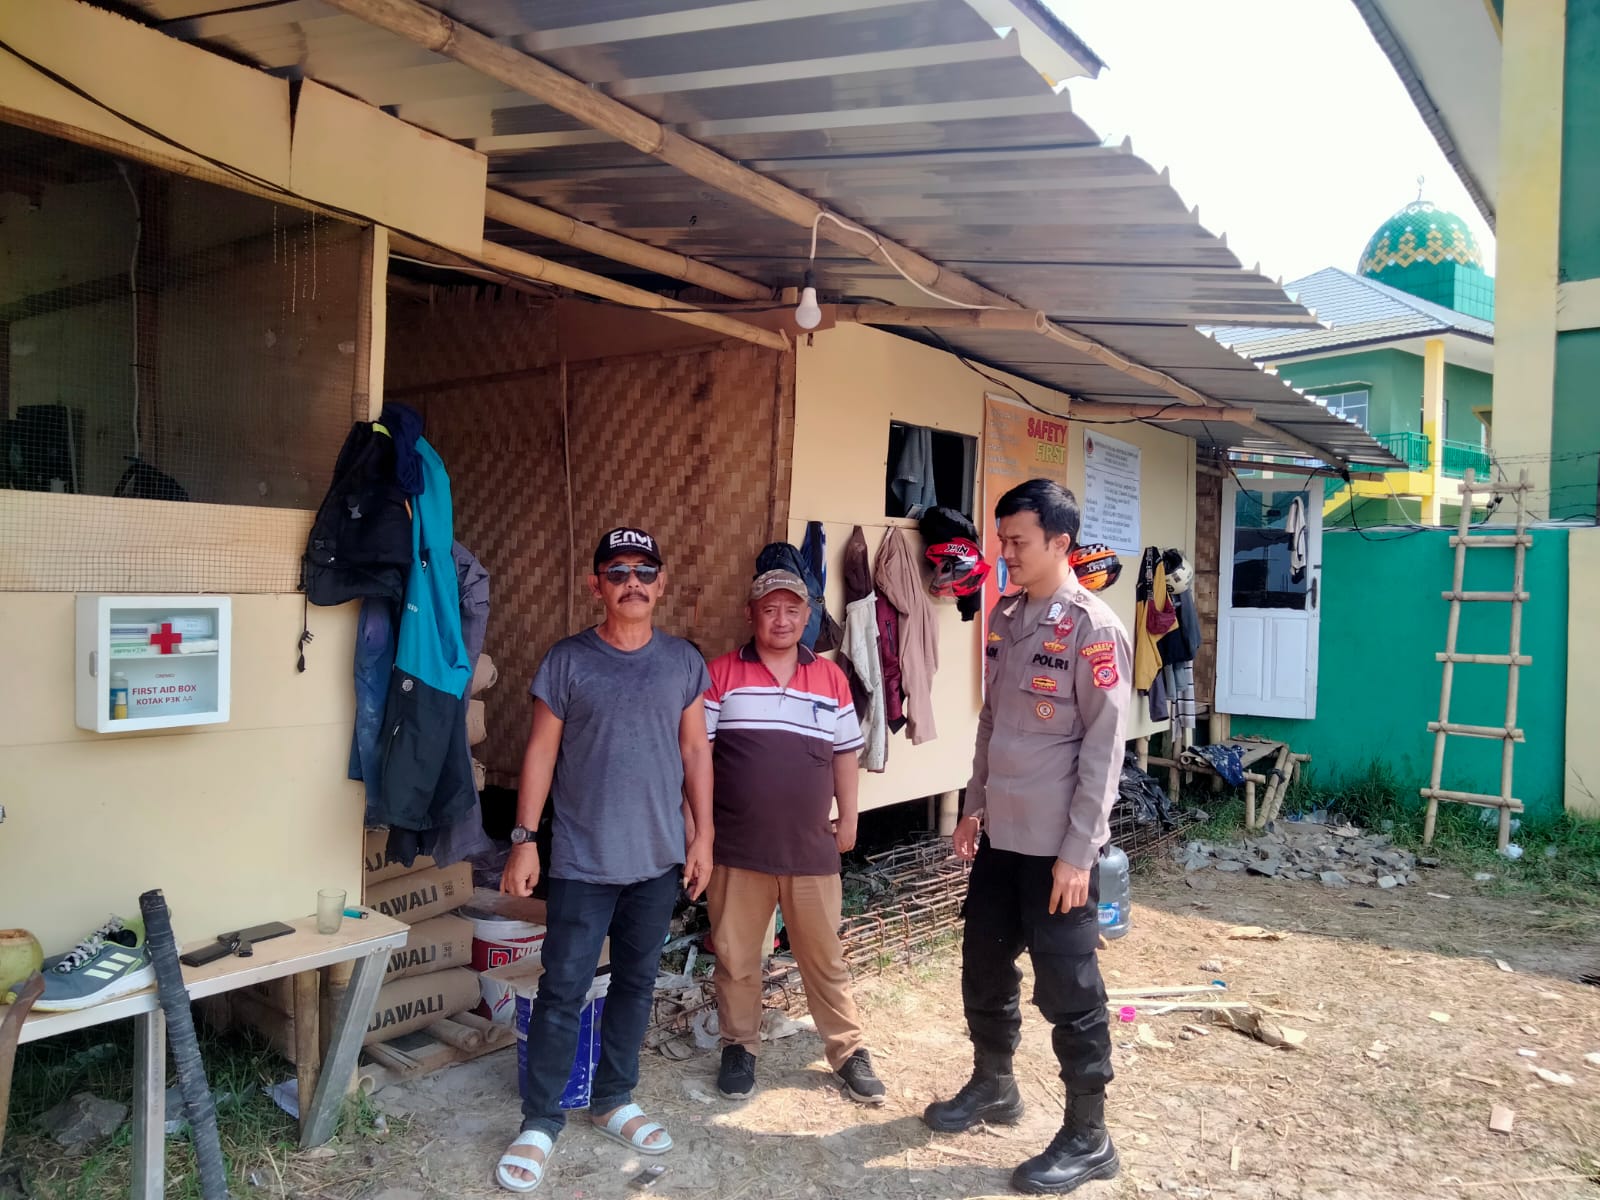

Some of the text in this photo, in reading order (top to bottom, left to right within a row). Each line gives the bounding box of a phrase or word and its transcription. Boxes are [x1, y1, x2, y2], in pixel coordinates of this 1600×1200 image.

[1027, 417, 1068, 444] SAFETY
[1035, 442, 1066, 464] FIRST
[1032, 653, 1069, 671] POLRI
[132, 684, 197, 695] FIRST AID BOX
[136, 697, 163, 705] KOTAK
[165, 696, 180, 704] P3K
